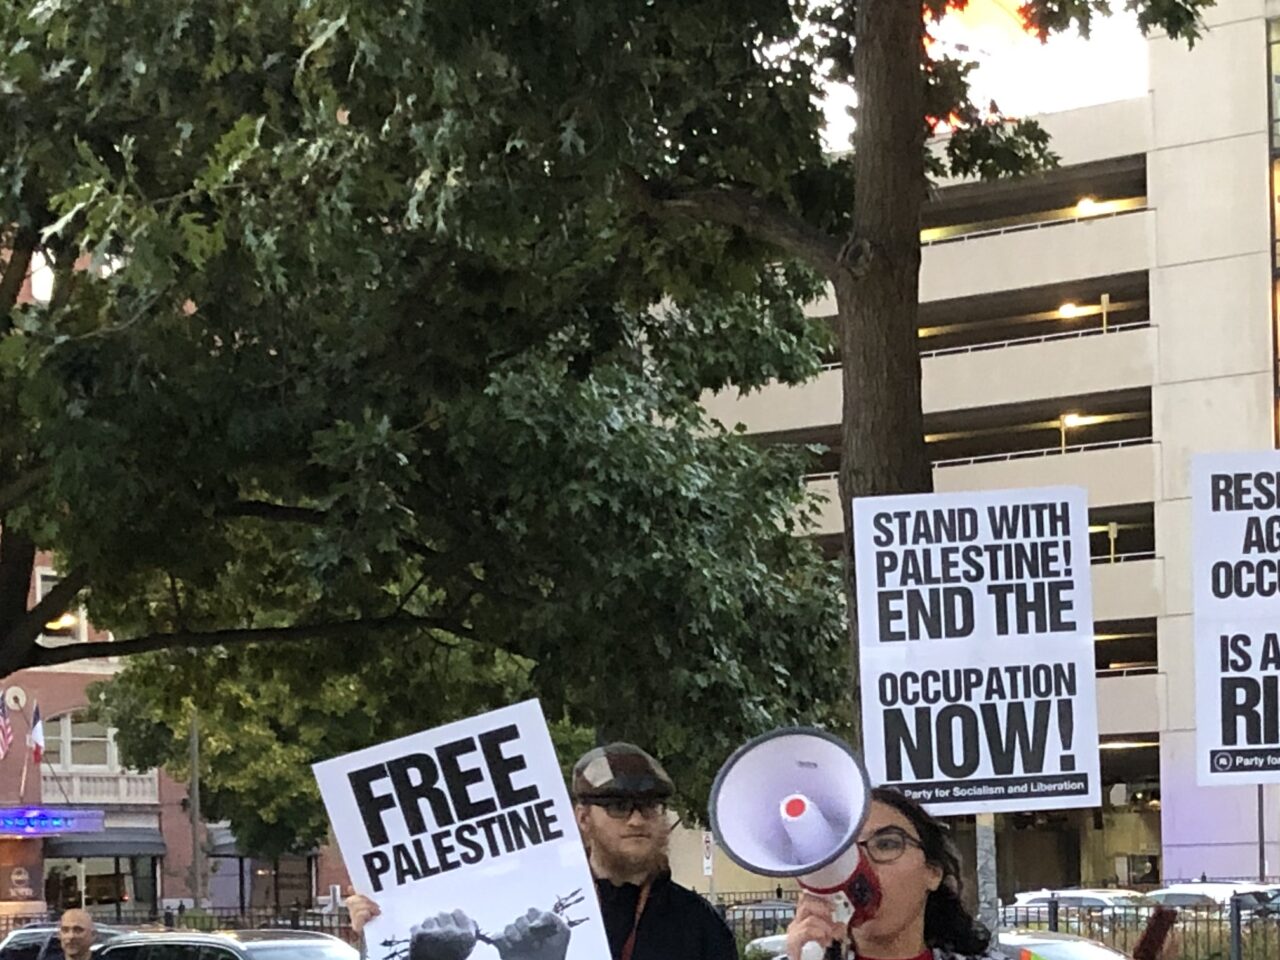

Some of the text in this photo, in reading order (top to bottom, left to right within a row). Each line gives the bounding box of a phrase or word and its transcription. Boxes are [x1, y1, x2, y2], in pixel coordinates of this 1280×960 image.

[873, 502, 1070, 547] STAND WITH
[876, 540, 1073, 588] PALESTINE!
[877, 580, 1077, 642] END THE
[1220, 634, 1252, 672] IS
[878, 662, 1077, 706] OCCUPATION
[883, 699, 1076, 781] NOW!
[1235, 755, 1264, 767] Party
[348, 724, 540, 848] FREE
[904, 780, 1085, 800] Party for Socialism and Liberation
[363, 799, 564, 893] PALESTINE
